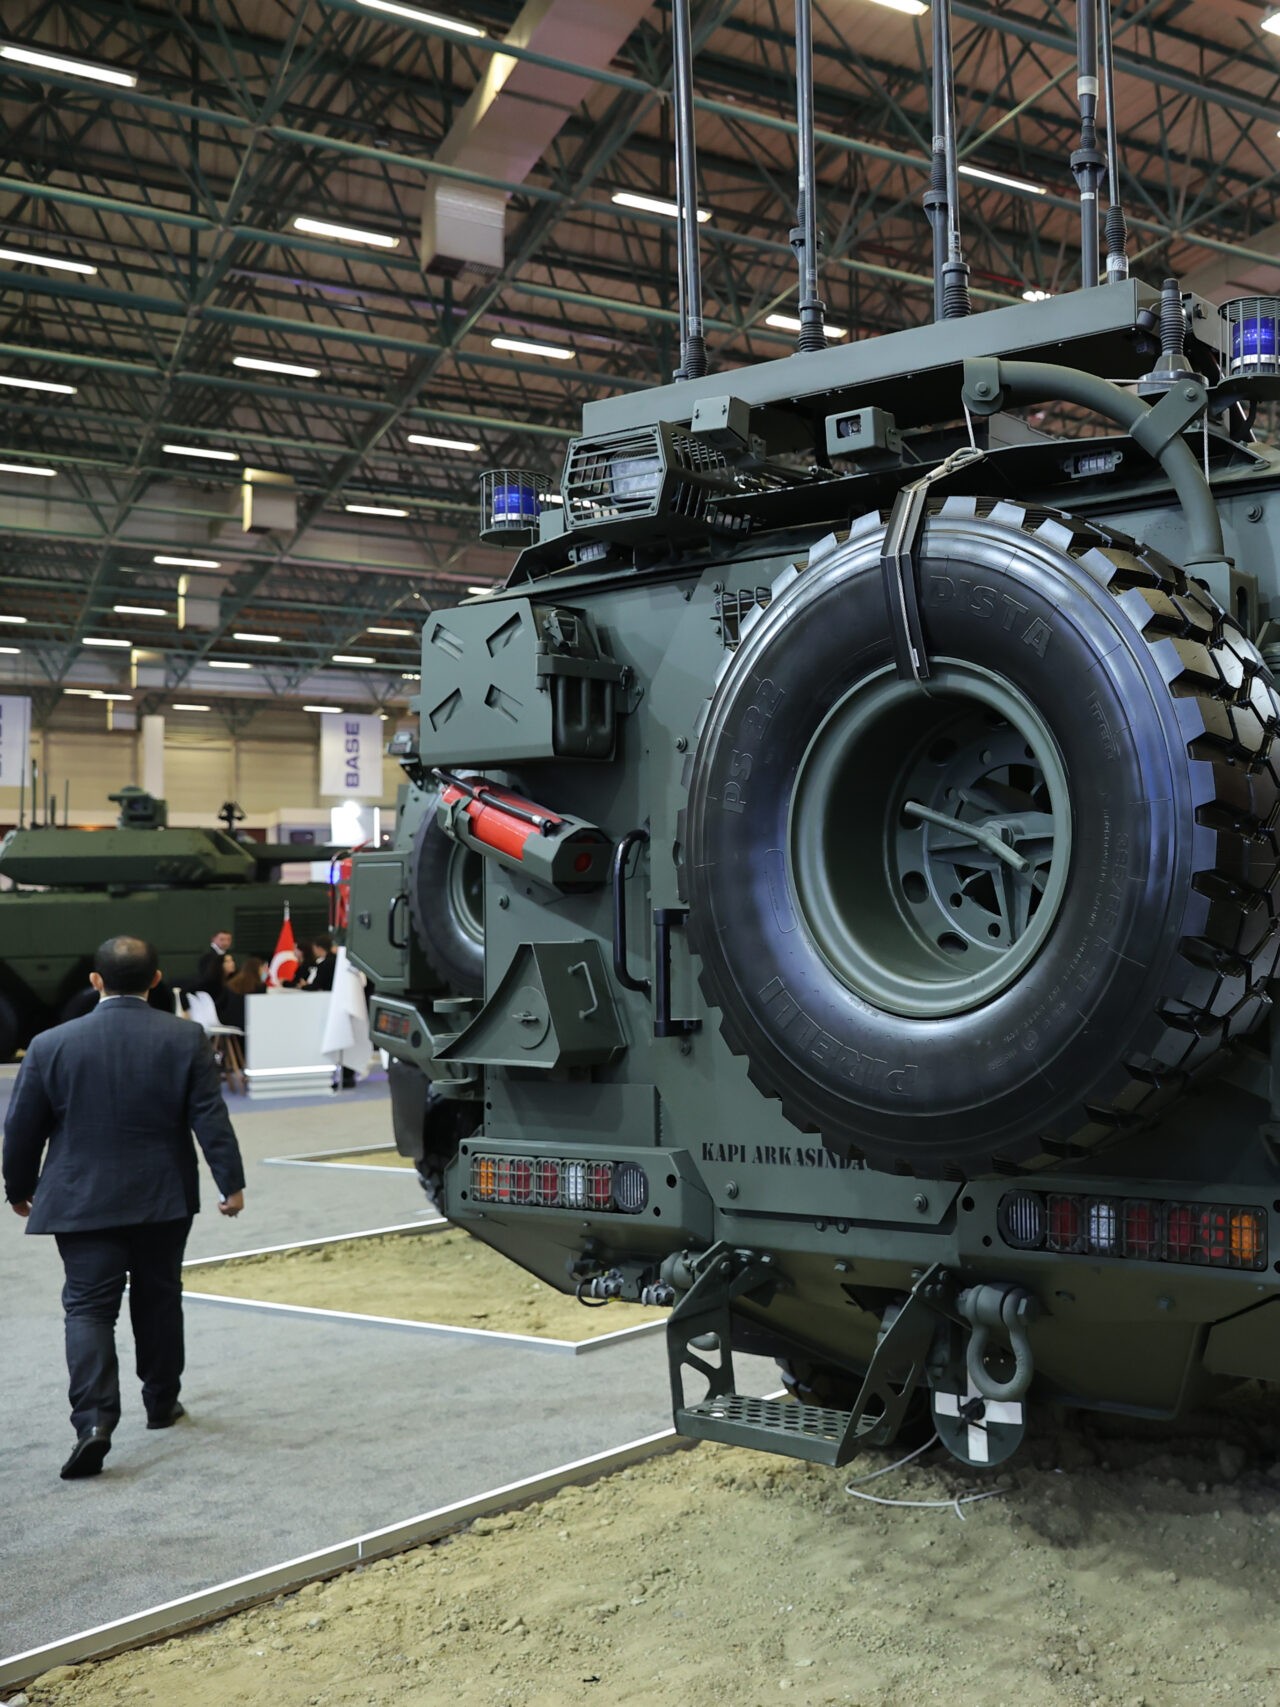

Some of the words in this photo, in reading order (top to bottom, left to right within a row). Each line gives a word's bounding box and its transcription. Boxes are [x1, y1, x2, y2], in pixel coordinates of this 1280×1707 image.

[345, 722, 360, 788] BASE
[758, 975, 919, 1096] PIRELLI
[702, 1142, 746, 1163] KAPI
